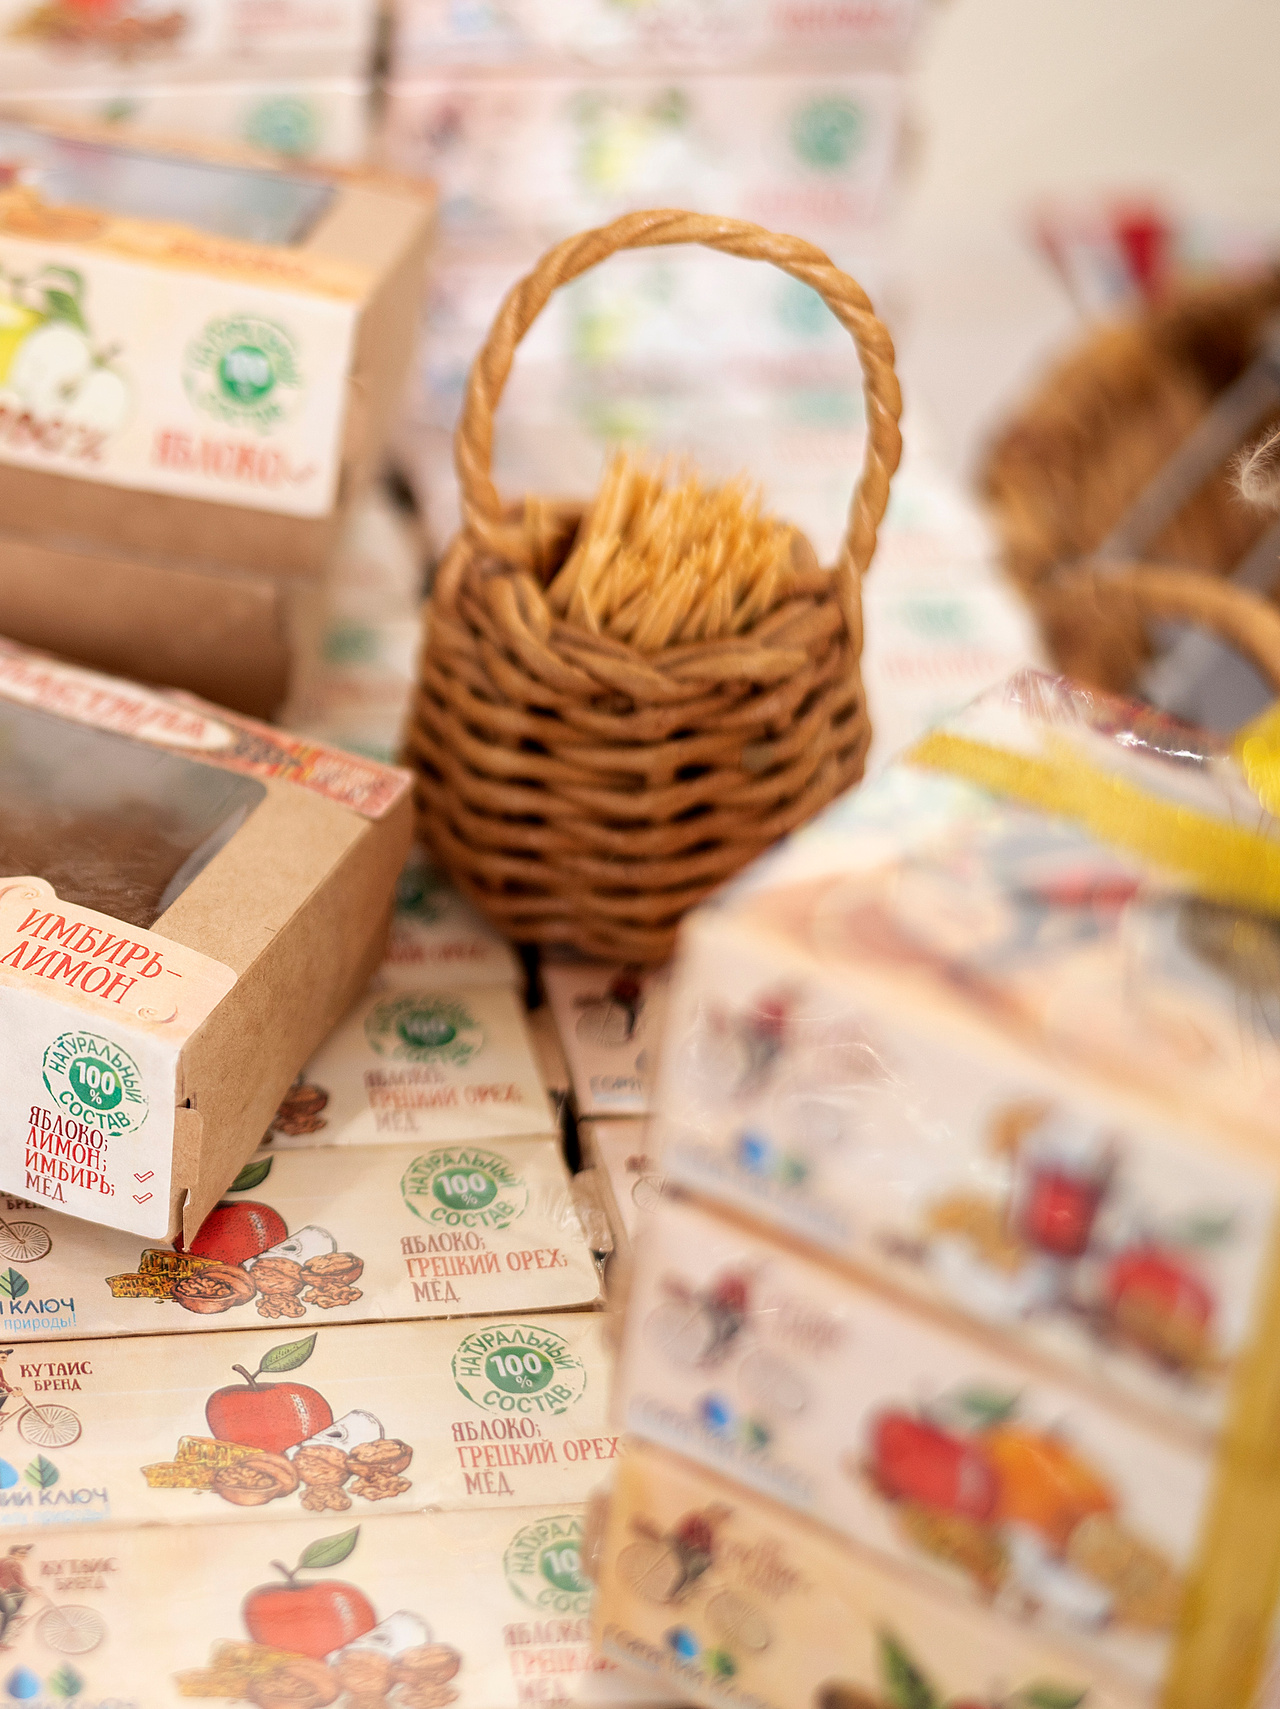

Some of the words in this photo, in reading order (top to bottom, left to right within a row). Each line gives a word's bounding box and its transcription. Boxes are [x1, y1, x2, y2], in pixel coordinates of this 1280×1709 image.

[48, 1036, 148, 1105] НАТУРАЛЬНЫЙ
[74, 1061, 117, 1096] 100
[58, 1090, 131, 1131] СОСТАВ
[88, 1088, 103, 1105] %
[28, 1105, 109, 1152] ЯБЛОКО;
[25, 1125, 108, 1172] ЛИМОН;
[24, 1147, 116, 1197] ИМБИРЬ;
[24, 1169, 68, 1205] МЁД.
[406, 1151, 523, 1197] НАТУРАЛЬНЫЙ
[439, 1172, 488, 1197] 100
[429, 1201, 517, 1229] СОСТАВ
[400, 1230, 486, 1256] ЯБЛОКО;
[405, 1250, 502, 1279] ГРЕЦКИЙ
[505, 1248, 569, 1272] ОРЕХ;
[9, 1297, 76, 1315] КЛЮЧ
[4, 1312, 77, 1334] природы!
[458, 1328, 583, 1378] НАТУРАЛЬНЫЙ
[489, 1352, 543, 1378] 100
[20, 1360, 94, 1379] КУТАИС
[33, 1378, 82, 1392] БРЕНД
[482, 1383, 573, 1414] СОСТАВ
[450, 1417, 542, 1443] ЯБЛОКО;
[456, 1438, 558, 1469] ГРЕЦКИЙ
